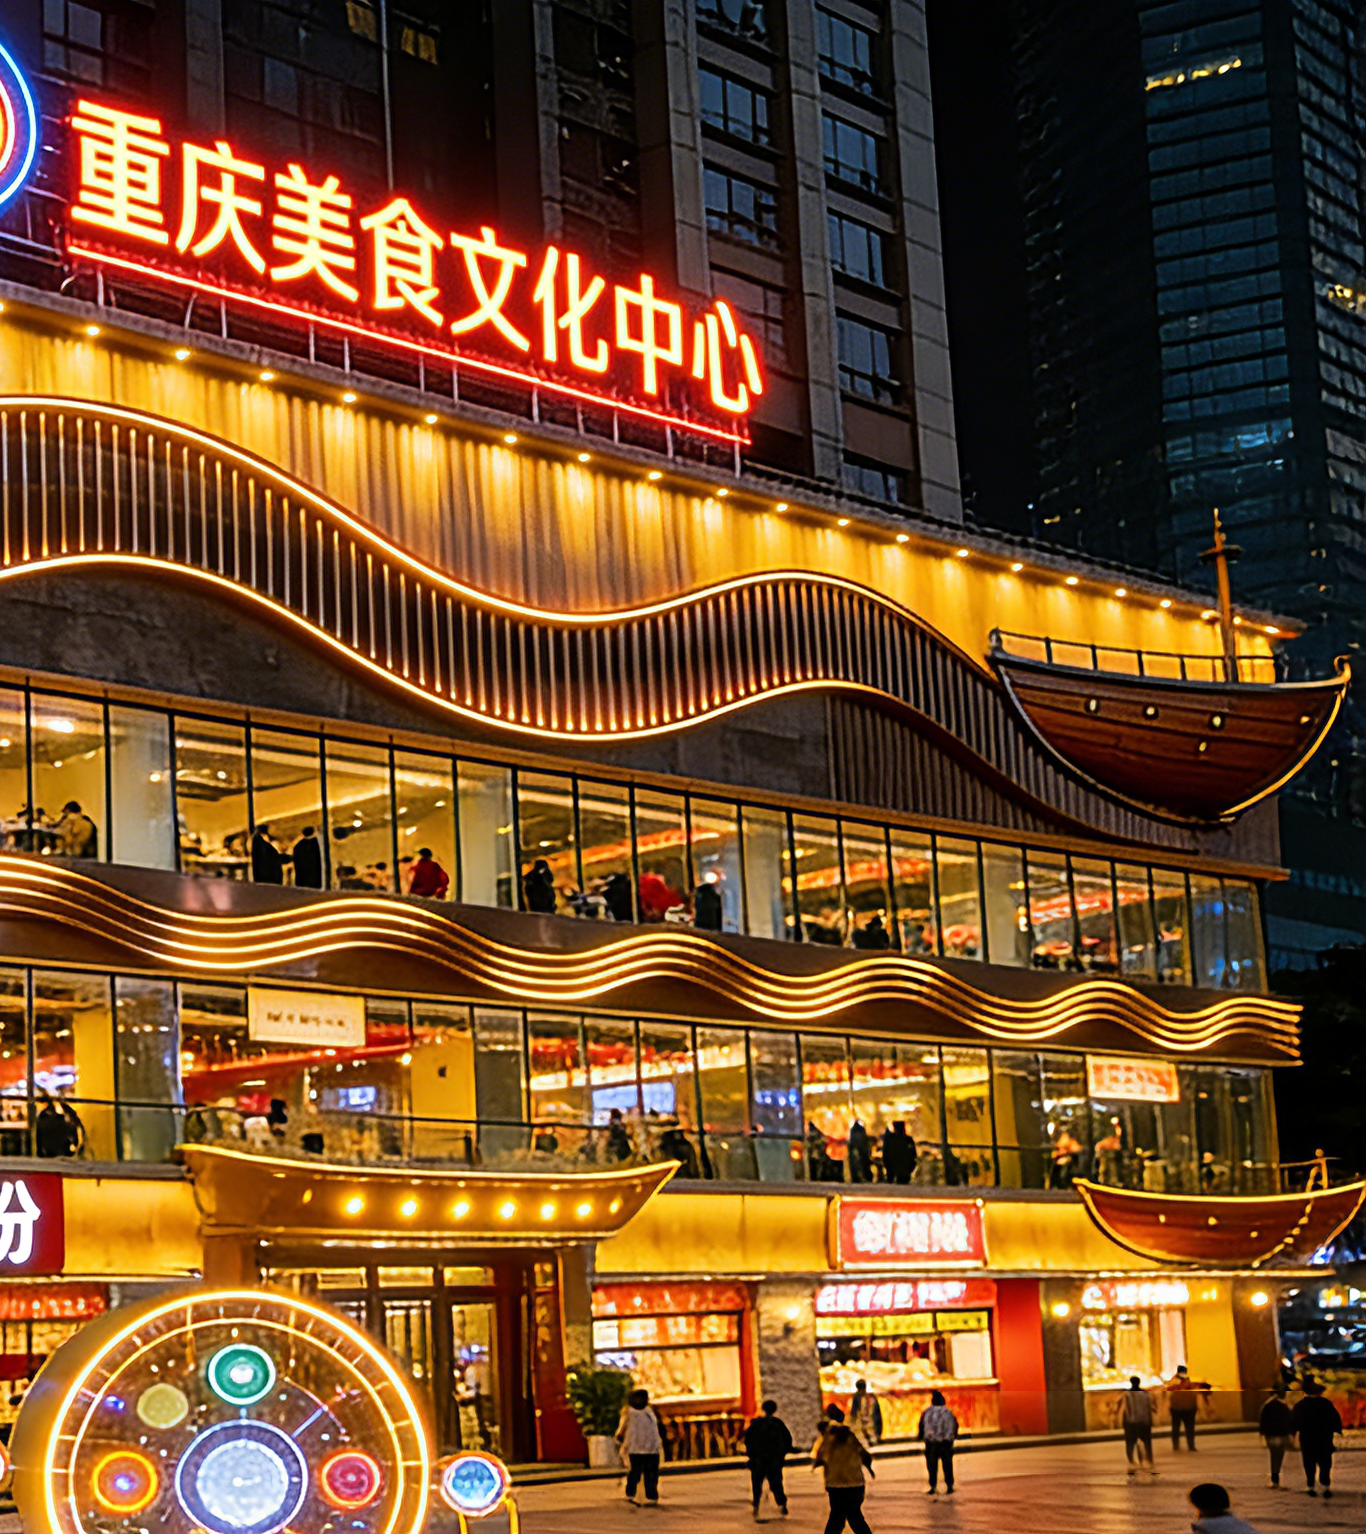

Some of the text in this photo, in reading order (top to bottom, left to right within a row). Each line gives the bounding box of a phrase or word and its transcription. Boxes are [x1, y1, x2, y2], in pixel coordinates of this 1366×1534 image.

[70, 99, 763, 414] 重庆美食文化中心
